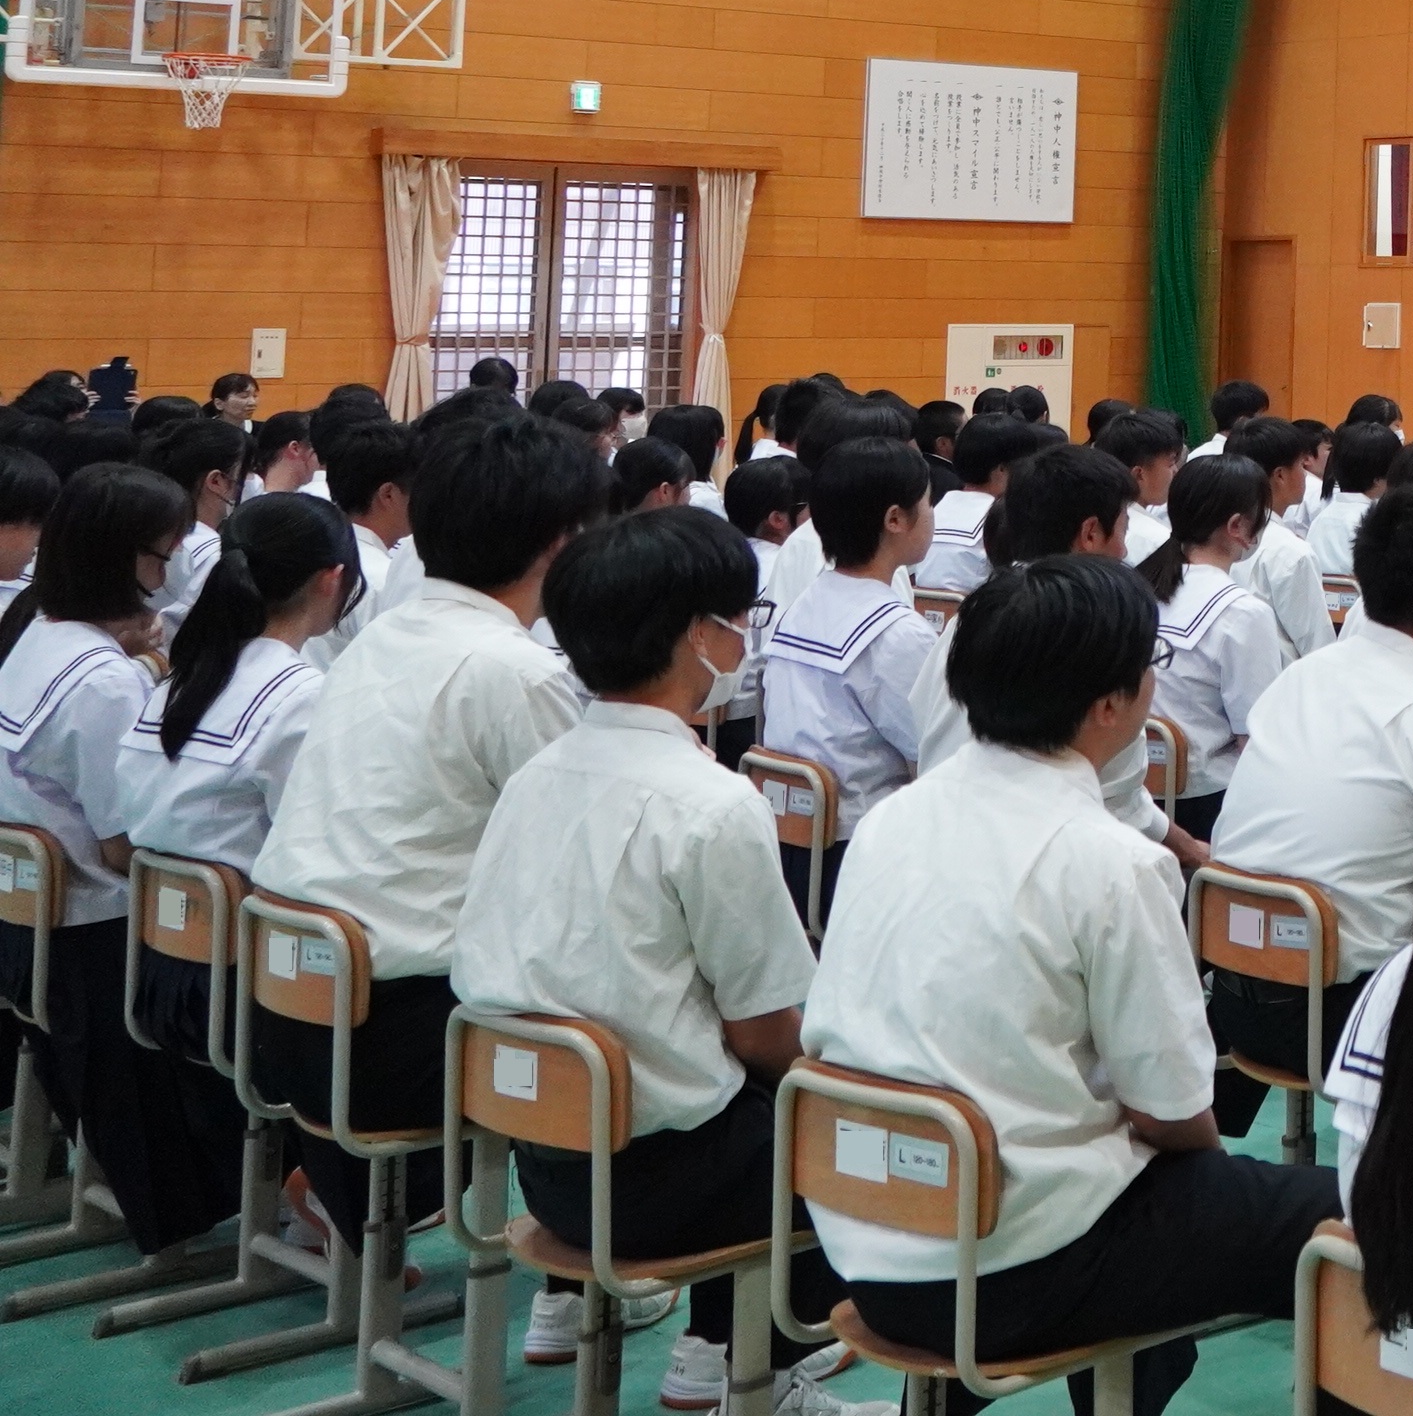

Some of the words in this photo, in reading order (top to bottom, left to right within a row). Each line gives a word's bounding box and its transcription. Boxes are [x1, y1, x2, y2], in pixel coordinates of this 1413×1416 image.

[970, 106, 982, 190] 神中スマイル宣言
[1052, 111, 1063, 185] 神中人権宣言
[899, 1148, 907, 1164] L
